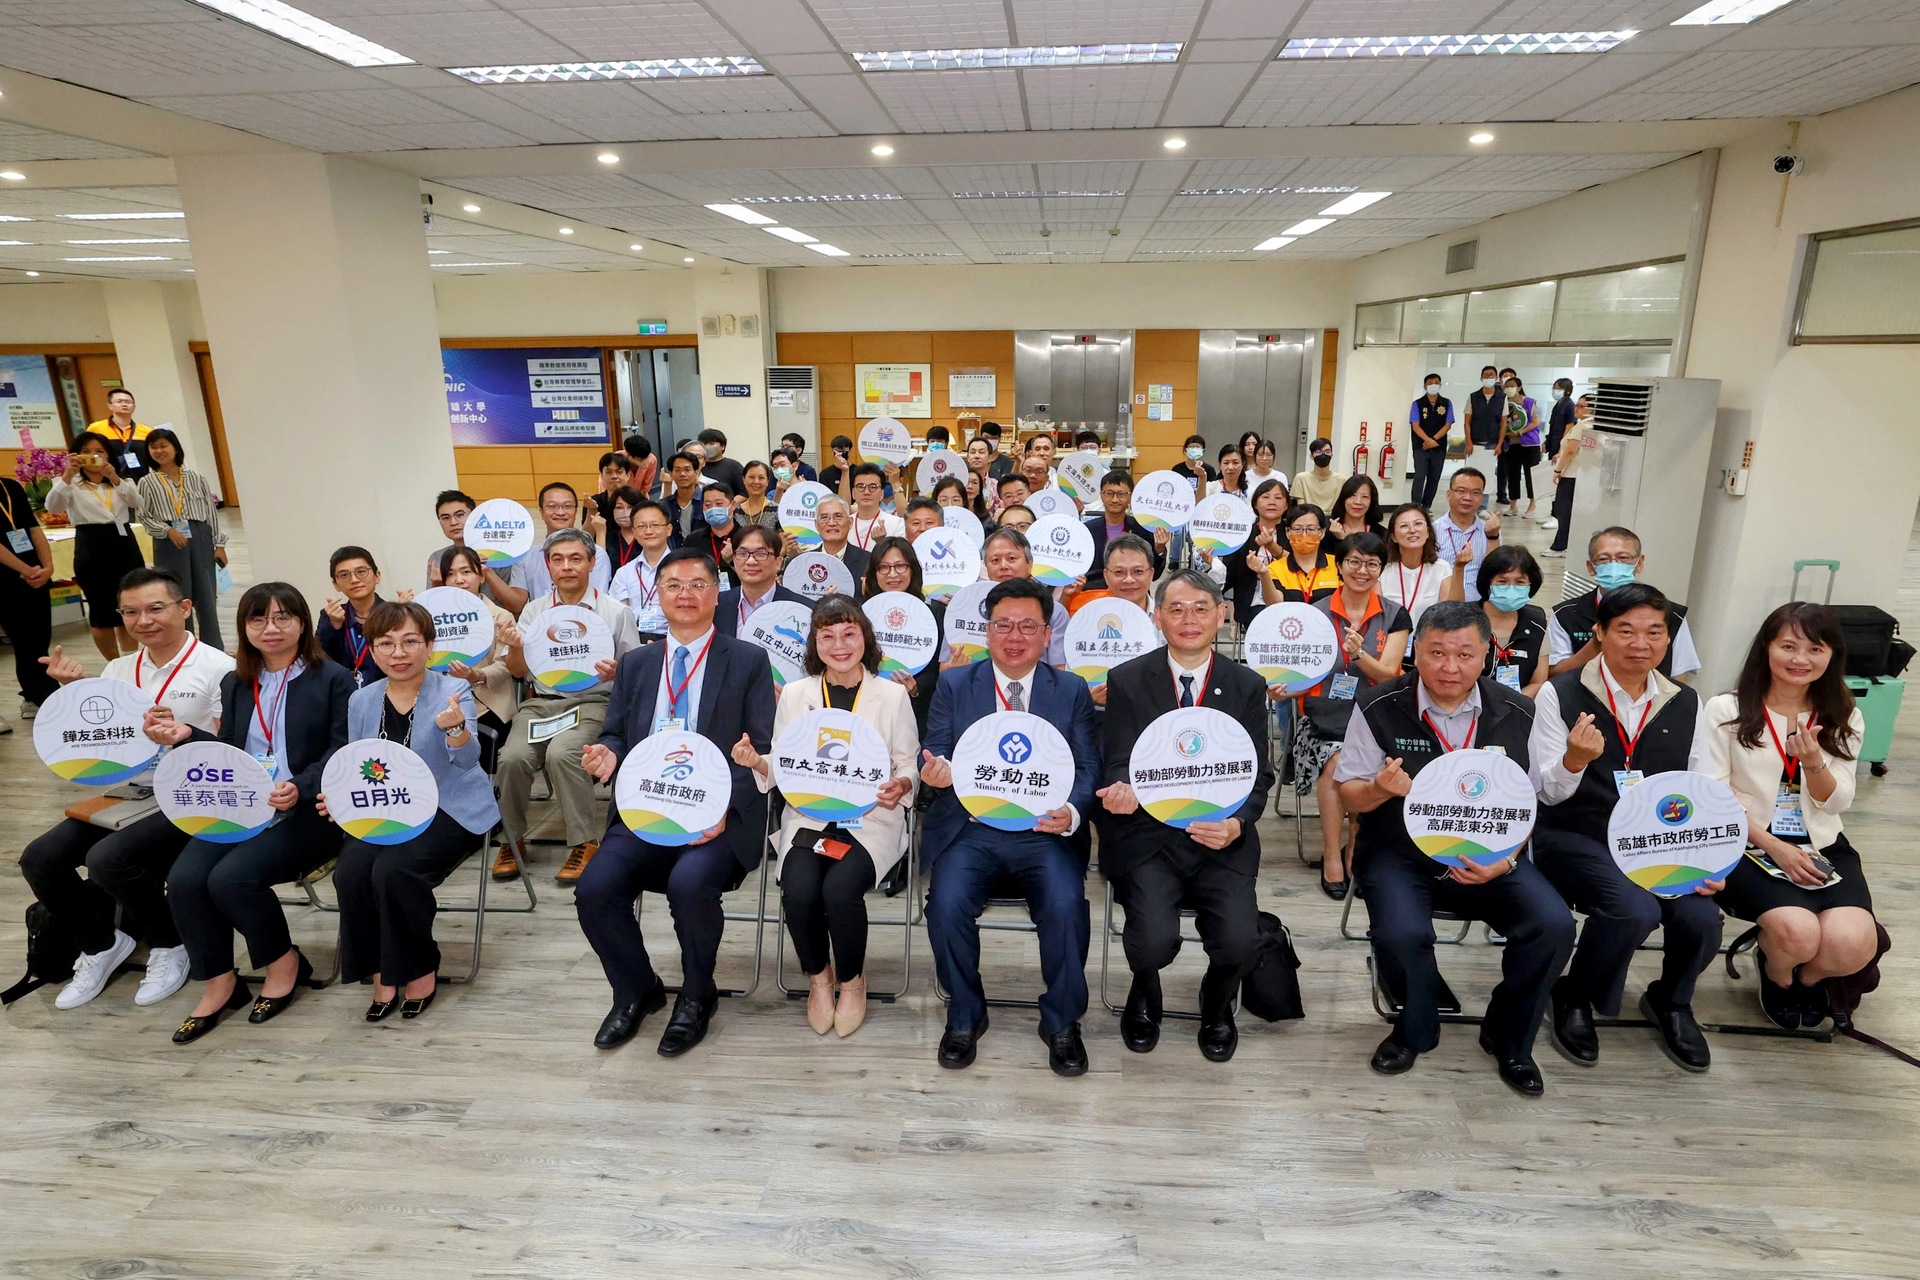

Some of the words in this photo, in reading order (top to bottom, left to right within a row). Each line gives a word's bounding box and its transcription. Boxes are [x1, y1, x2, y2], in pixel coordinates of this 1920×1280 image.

[861, 441, 908, 450] 國立高雄科技大學
[1065, 464, 1096, 494] 文藻外語大學
[1136, 495, 1191, 512] 大仁科技大學
[494, 521, 526, 529] DELTA
[1193, 519, 1248, 532] 楠梓科技產業園區
[482, 530, 515, 539] 台達電子
[434, 626, 469, 638] 創資通
[875, 631, 933, 648] 高雄師範大學
[549, 643, 590, 657] 建佳科技
[1075, 641, 1144, 653] 國立屏東大學
[1249, 642, 1332, 655] 高雄市政府勞工局
[1259, 654, 1322, 666] 訓練就業中心
[187, 768, 234, 782] OSE
[779, 757, 884, 782] 國立高雄大學
[974, 764, 1050, 788] 勞動部
[1135, 760, 1253, 783] 勞動部勞動力發展署
[808, 773, 837, 783] University
[847, 780, 878, 788] Kaohsiung
[1164, 780, 1194, 788] DEVELOPMENT
[639, 778, 707, 803] 高雄市政府
[974, 782, 1006, 793] Ministry
[1024, 788, 1048, 797] Labor
[172, 789, 259, 808] 華泰電子
[350, 788, 411, 808] 日月光
[644, 794, 665, 803] Kaohsiung
[673, 799, 696, 807] Government
[1408, 803, 1532, 822] 勞動部勞動力發展署
[1427, 818, 1509, 835] 高屏澎東分署
[1616, 823, 1741, 852] 高雄市政府勞工局
[1709, 839, 1738, 847] Government
